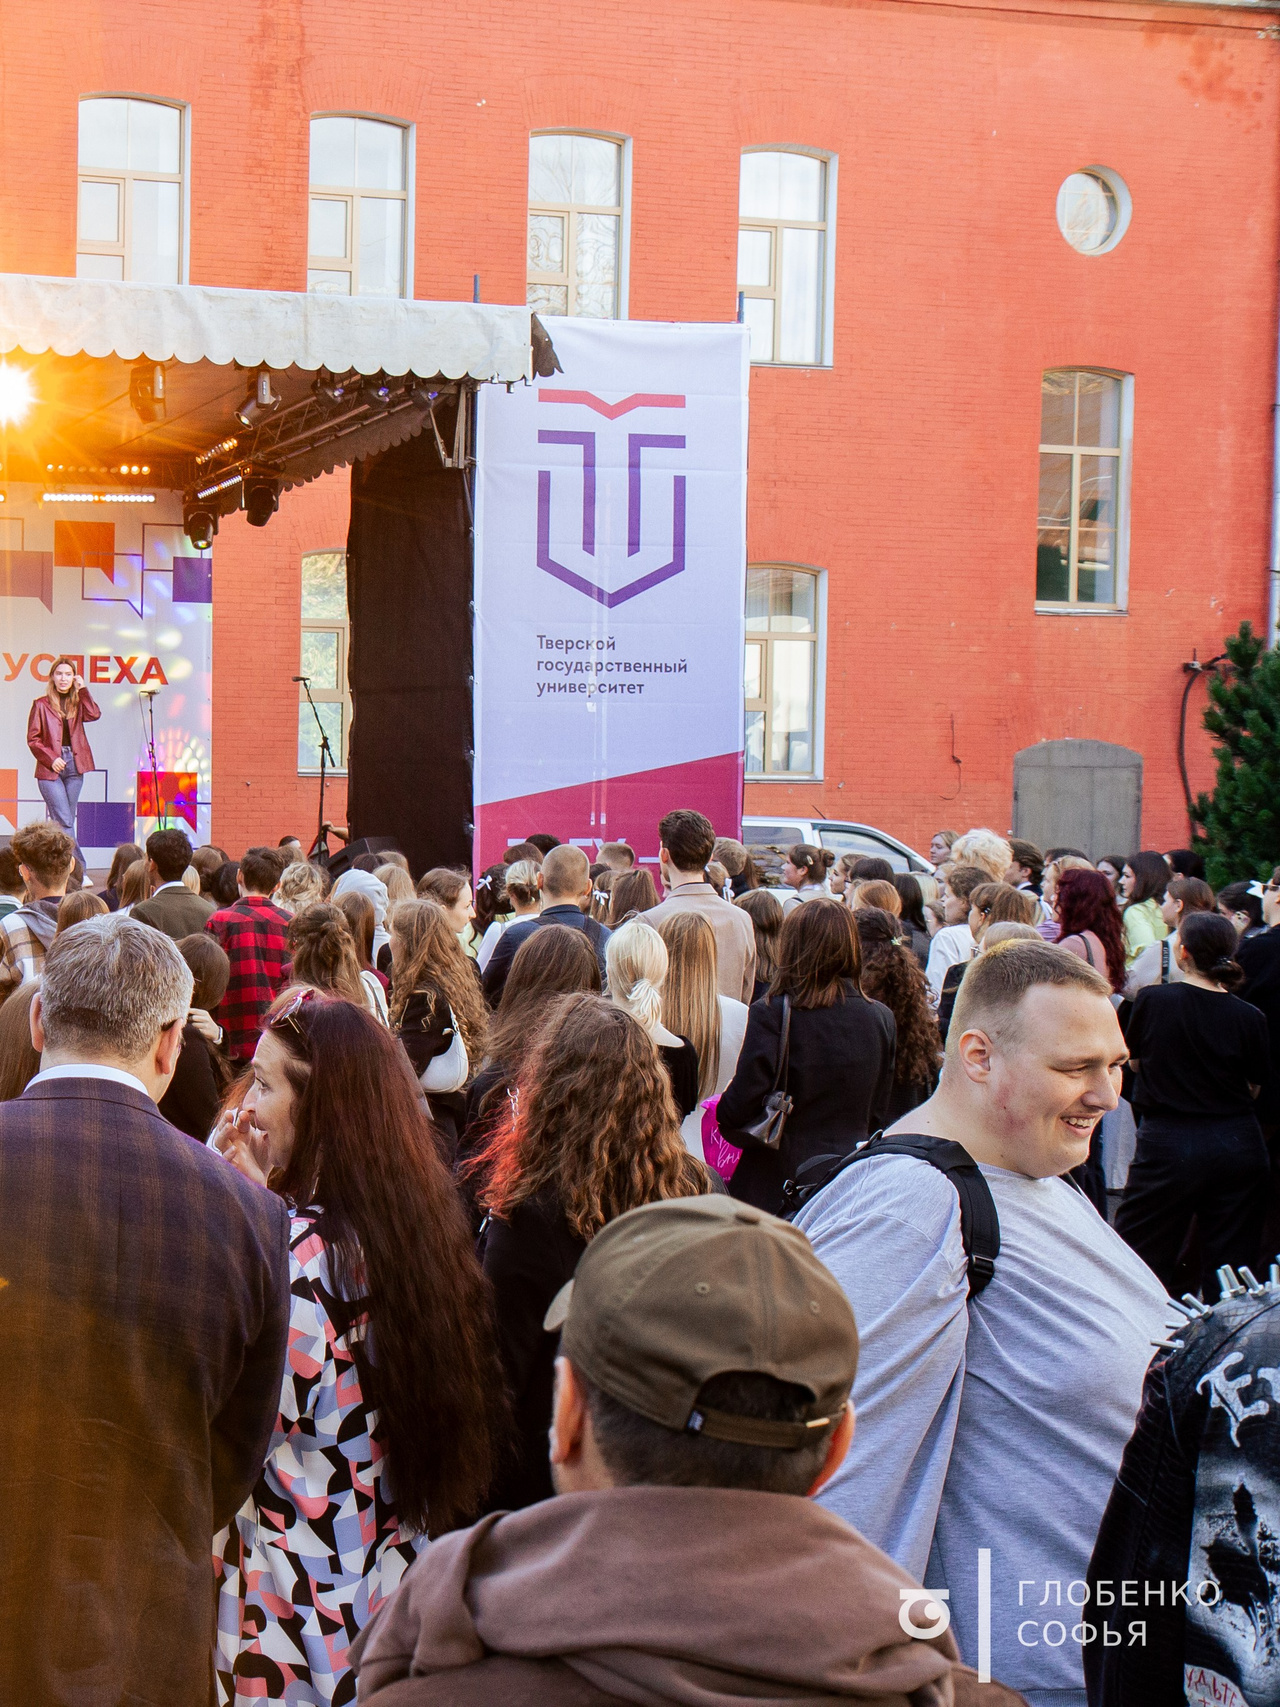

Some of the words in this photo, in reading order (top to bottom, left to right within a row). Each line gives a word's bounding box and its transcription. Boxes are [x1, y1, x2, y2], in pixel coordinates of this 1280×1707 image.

[536, 634, 616, 654] Тверской
[536, 658, 688, 676] государственный
[536, 680, 645, 698] университет
